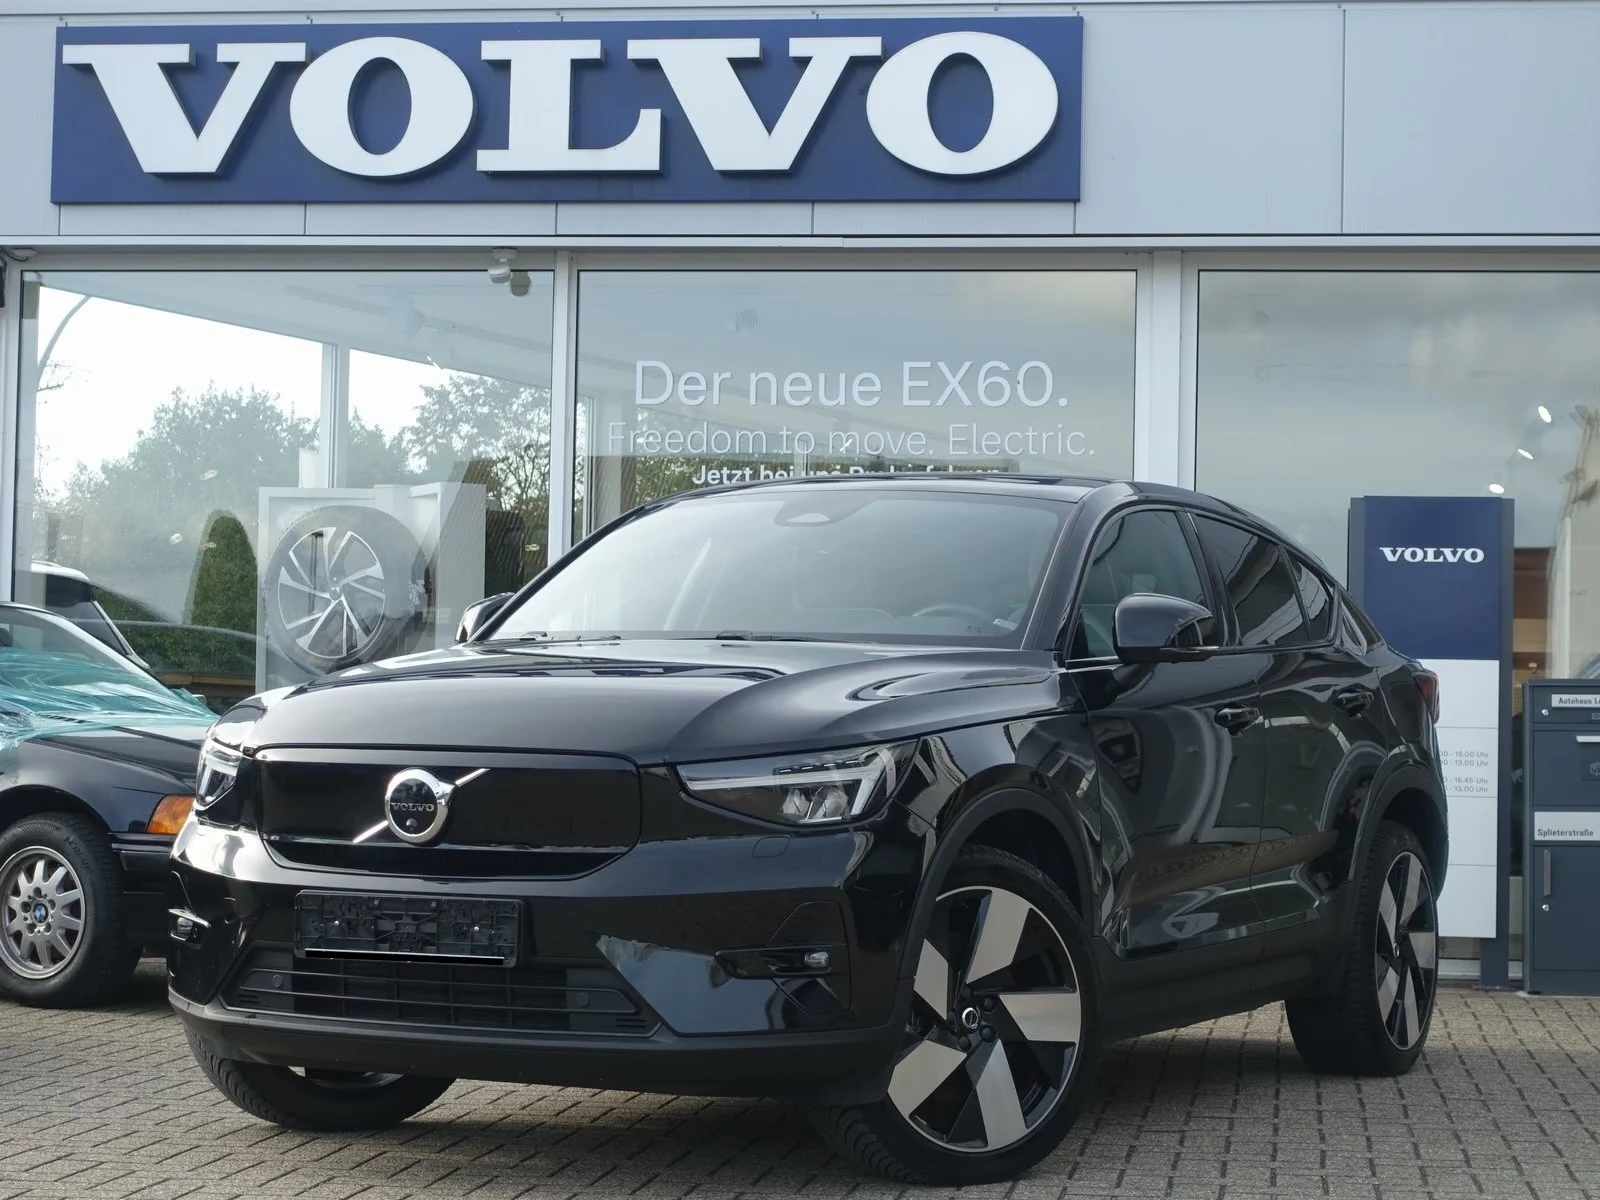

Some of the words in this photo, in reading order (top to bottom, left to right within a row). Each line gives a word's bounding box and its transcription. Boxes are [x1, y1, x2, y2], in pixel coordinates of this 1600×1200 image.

[62, 30, 1060, 178] VOLVO
[635, 359, 732, 406] Der
[749, 370, 882, 407] neue
[902, 360, 1069, 408] EX60.
[607, 420, 768, 455] Freedom
[779, 425, 816, 456] to
[828, 430, 934, 456] move.
[948, 422, 1096, 457] Electric.
[691, 464, 753, 486] Jetzt
[759, 464, 795, 482] bei
[1378, 546, 1485, 564] VOLVO
[1558, 696, 1593, 705] Autohaus
[1455, 750, 1475, 758] 18.00
[390, 802, 435, 812] VOLVO
[1537, 828, 1594, 838] Splieterstraße
